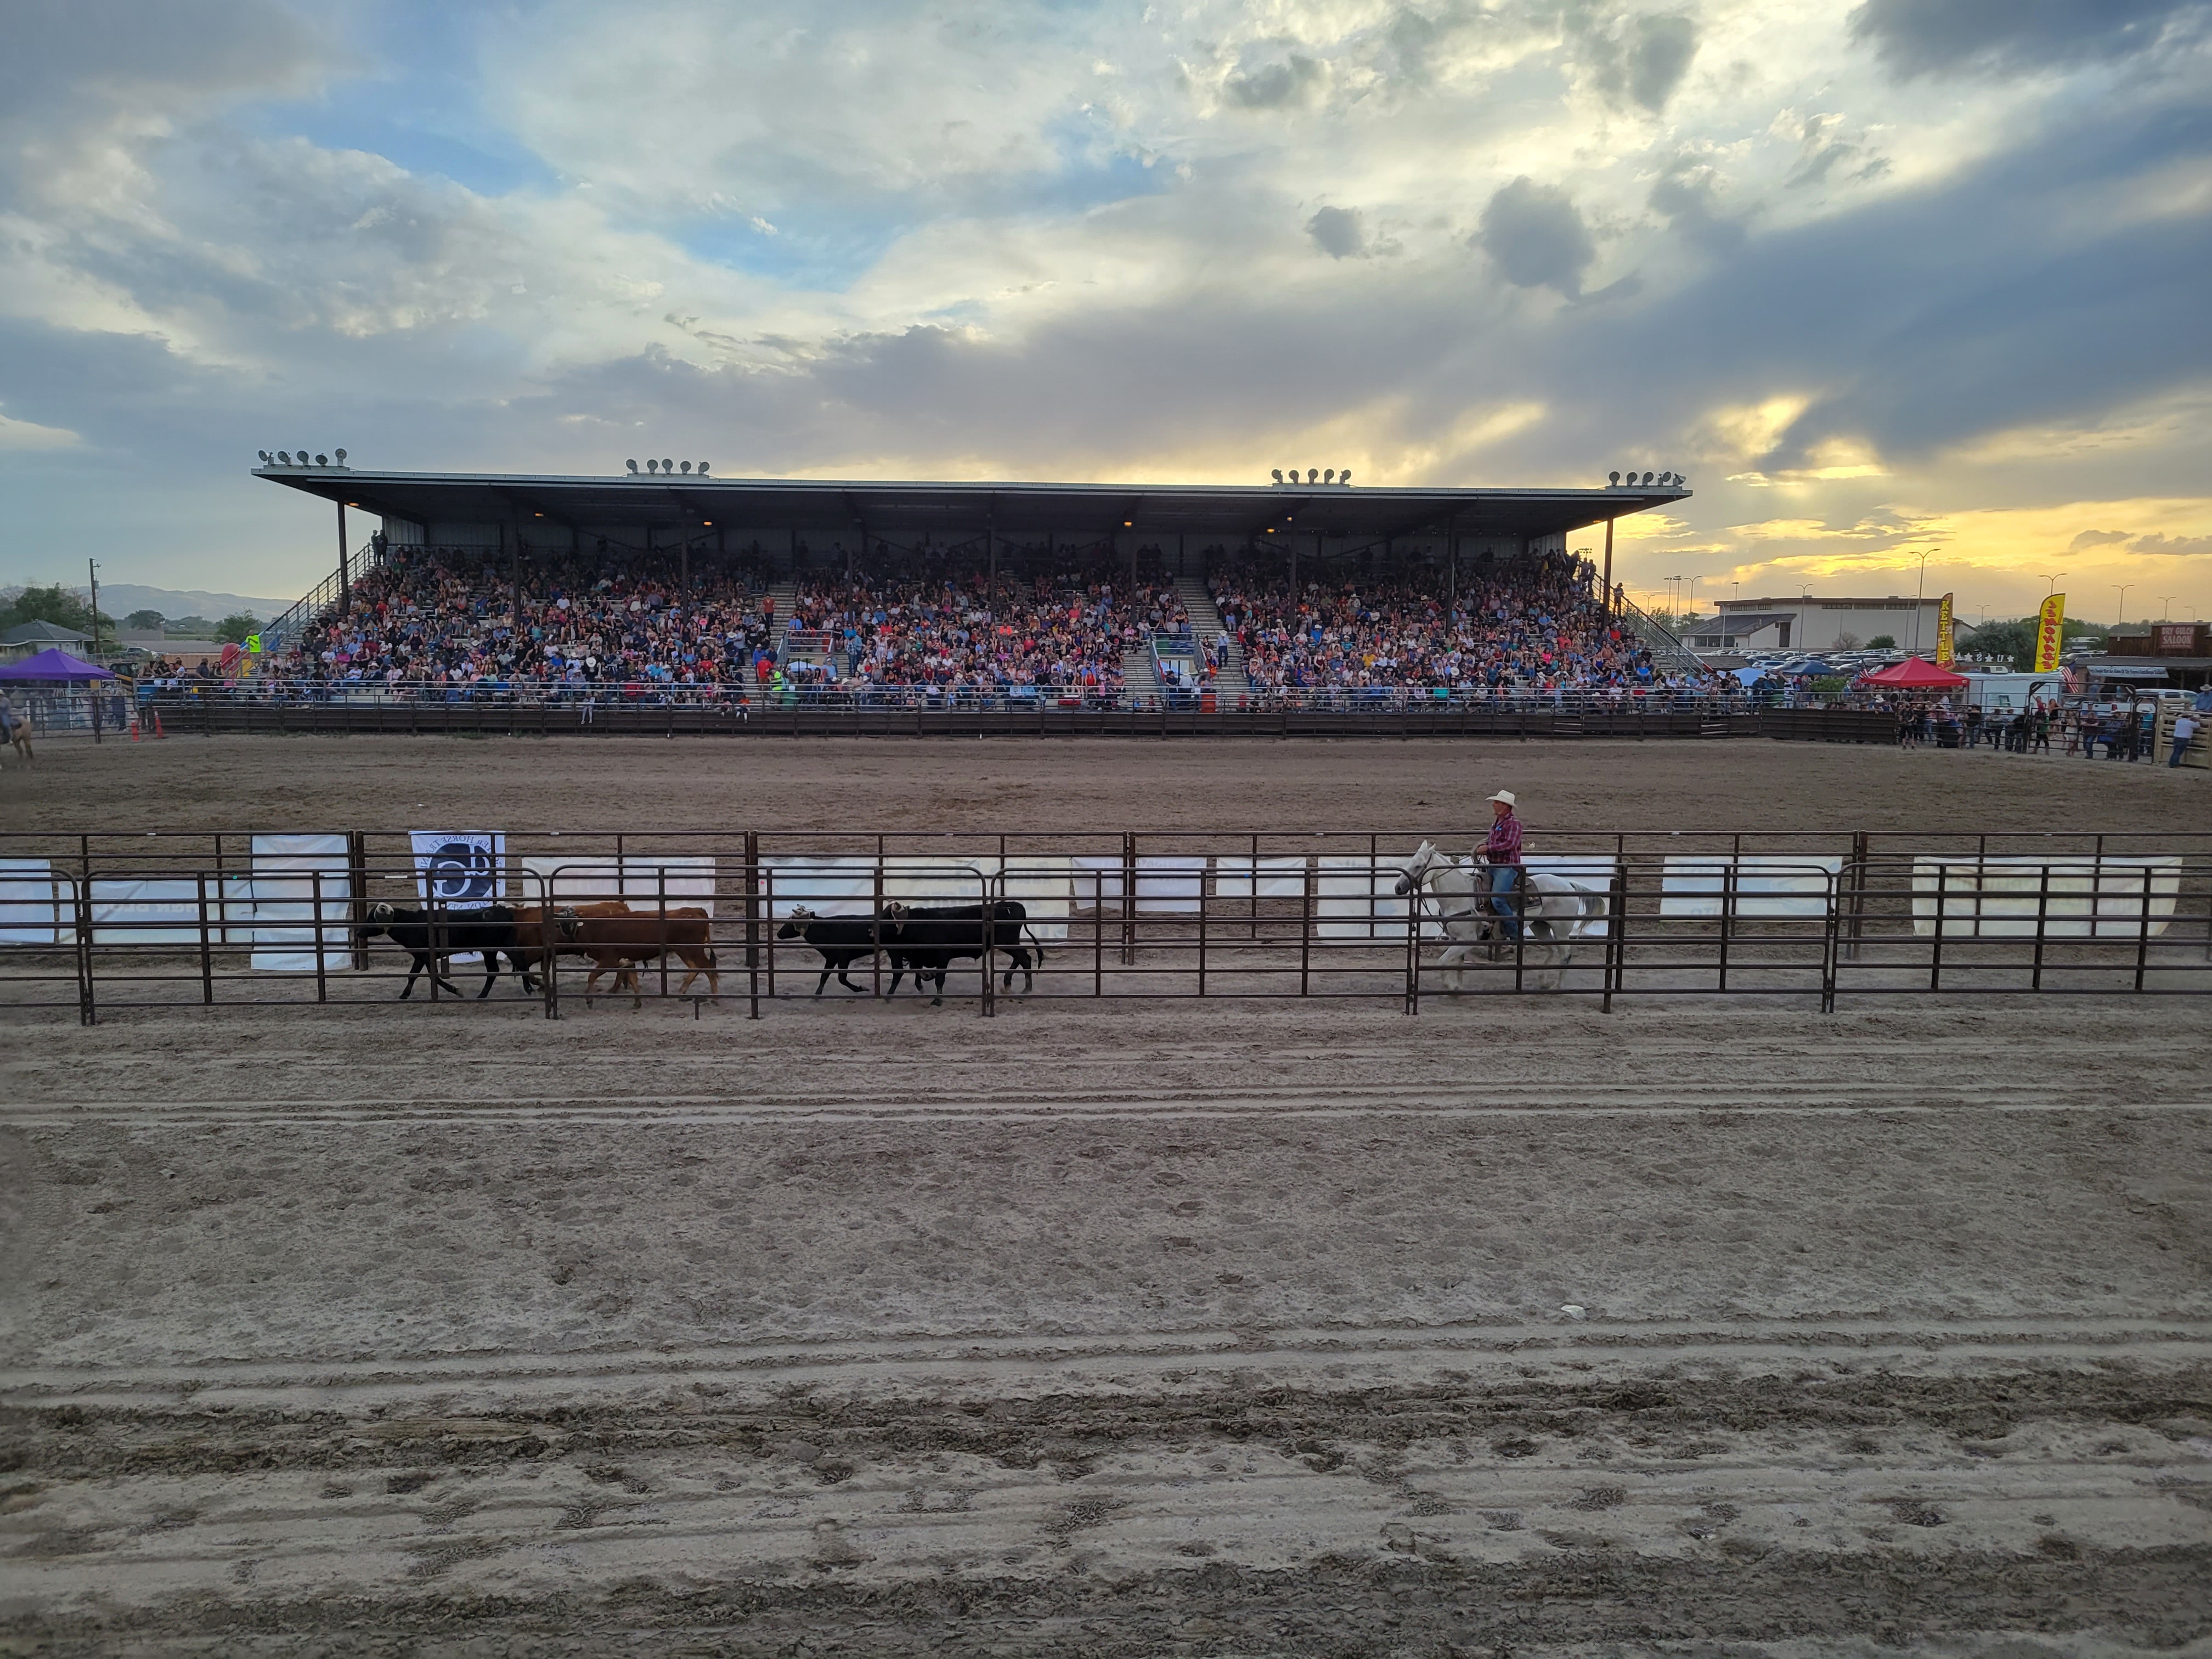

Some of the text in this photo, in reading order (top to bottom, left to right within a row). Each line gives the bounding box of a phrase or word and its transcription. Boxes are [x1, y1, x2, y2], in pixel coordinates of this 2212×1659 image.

[1940, 600, 1950, 661] KETTLE
[2175, 627, 2194, 635] GULCH
[2163, 635, 2192, 645] SALOON
